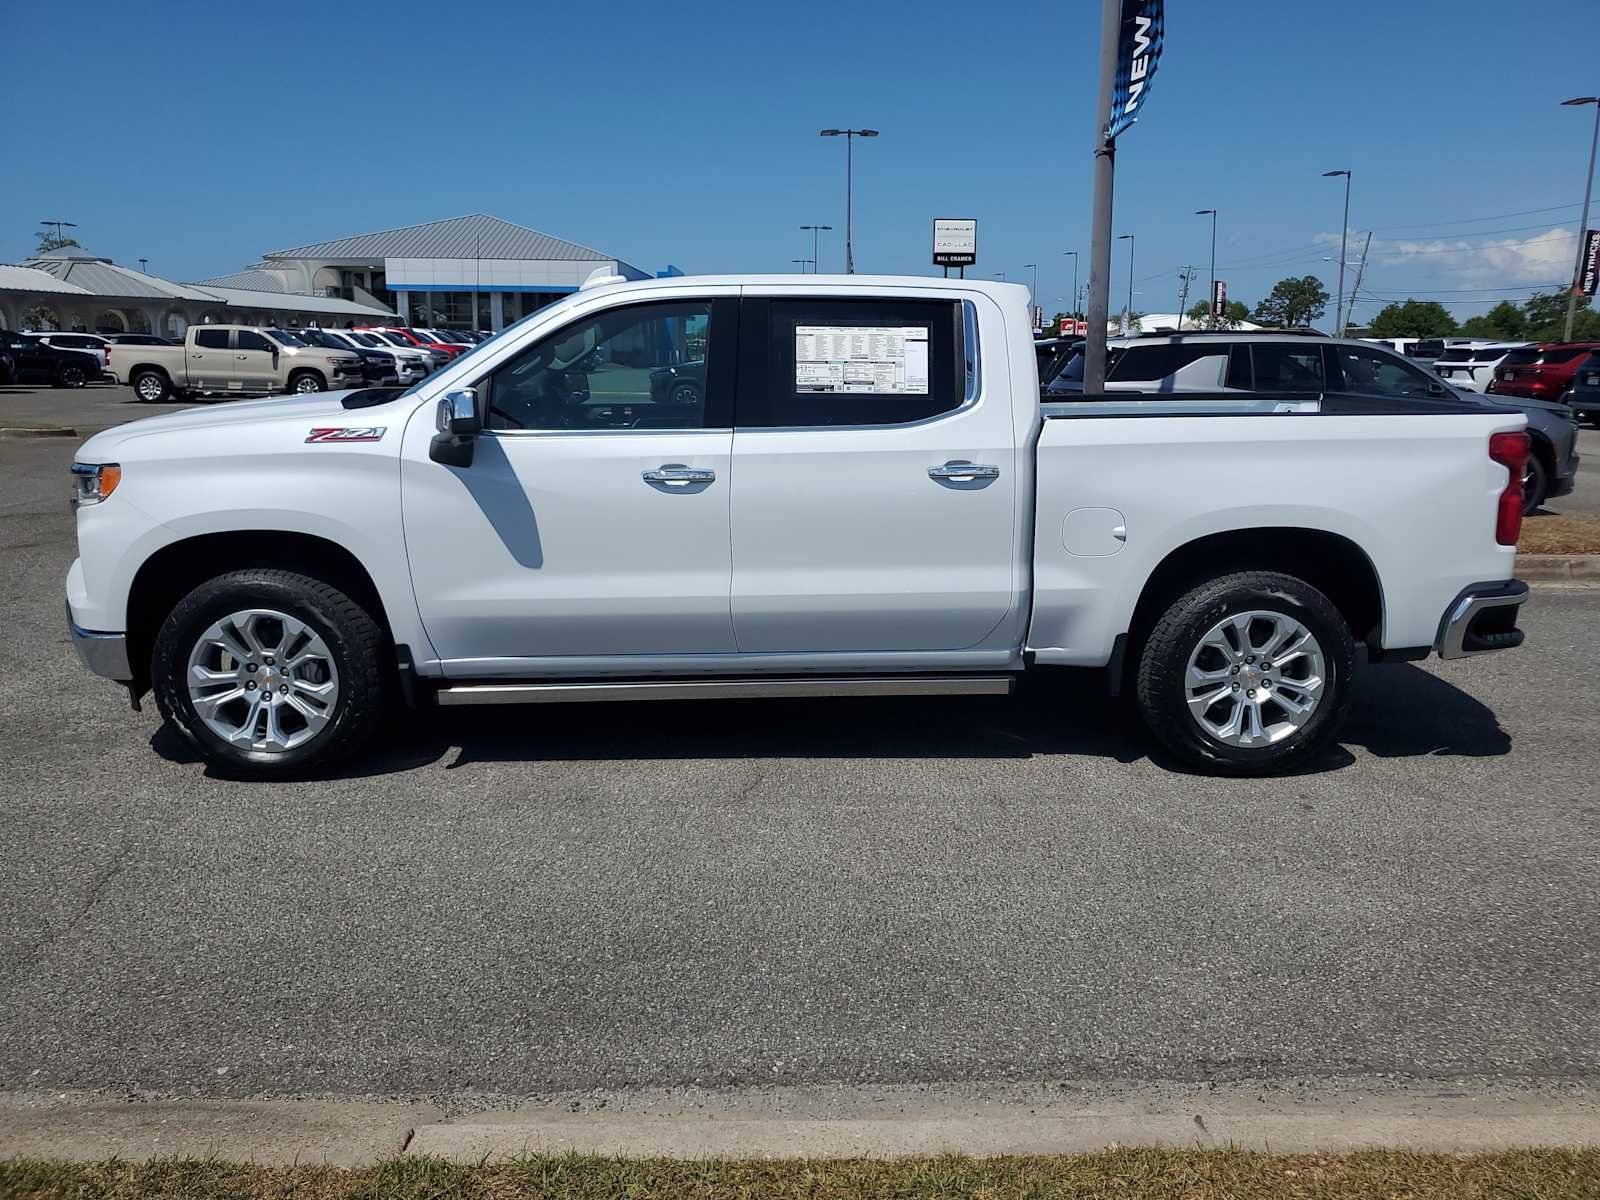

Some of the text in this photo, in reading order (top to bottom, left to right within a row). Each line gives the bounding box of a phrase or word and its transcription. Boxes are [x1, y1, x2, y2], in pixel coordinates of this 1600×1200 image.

[1124, 16, 1151, 114] NEW
[1584, 233, 1600, 292] NEW TRUCKS
[304, 427, 388, 443] Z71
